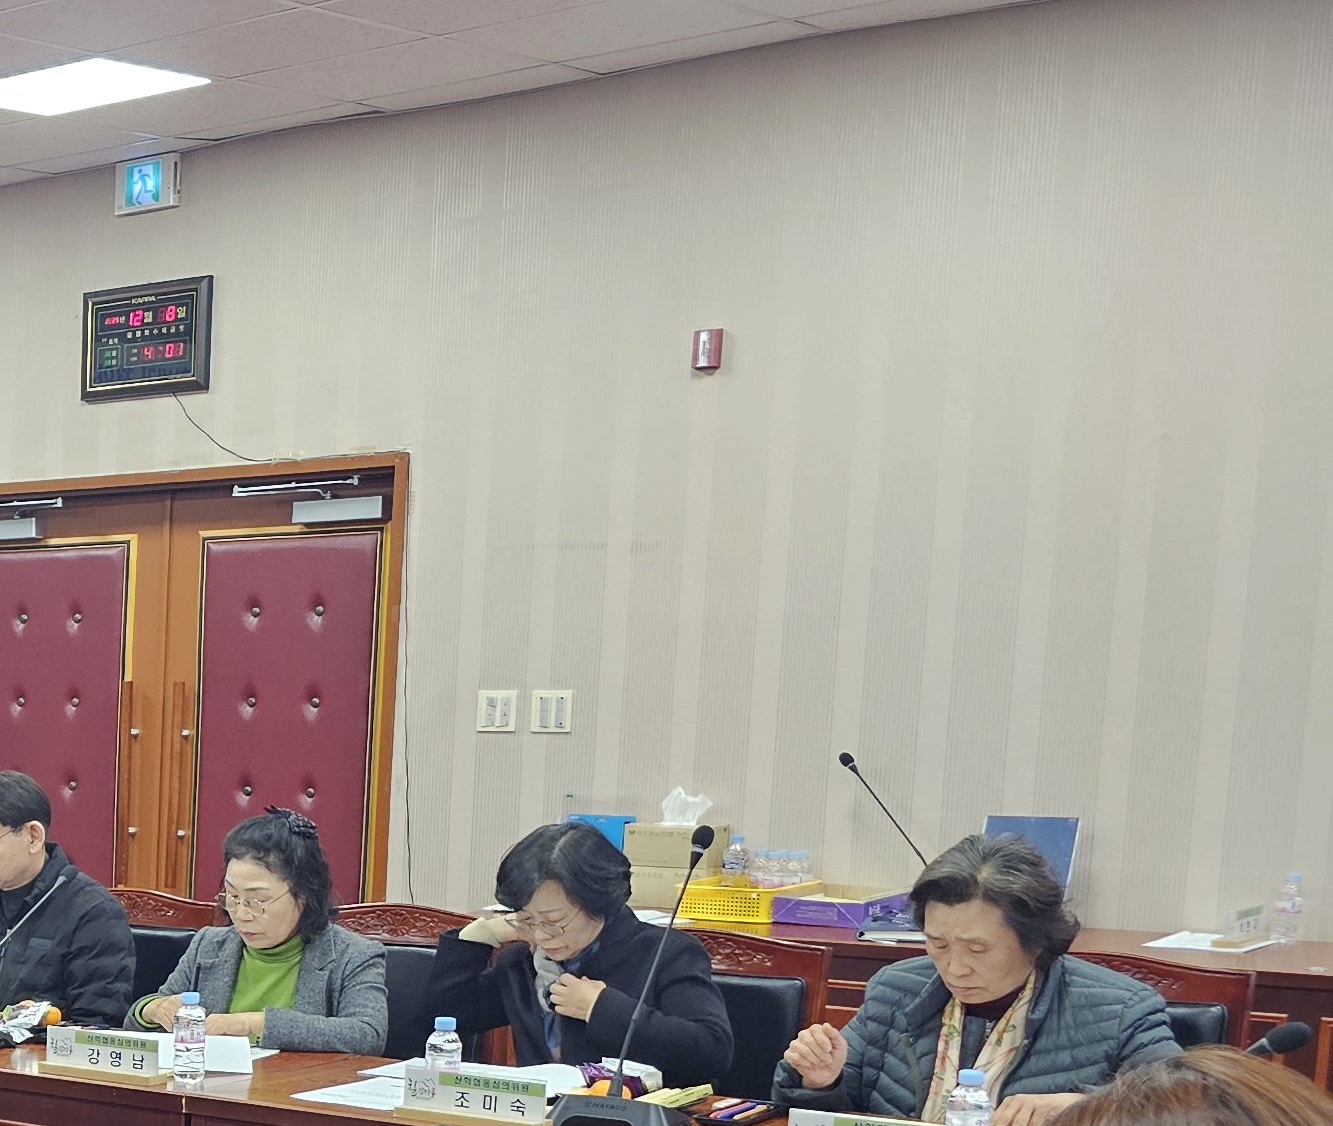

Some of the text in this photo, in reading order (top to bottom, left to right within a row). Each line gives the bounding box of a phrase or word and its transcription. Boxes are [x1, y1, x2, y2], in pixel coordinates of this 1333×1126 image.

[87, 1048, 145, 1071] 강영남
[453, 1075, 530, 1094] 산학협동심의위원
[454, 1091, 527, 1117] 조미숙
